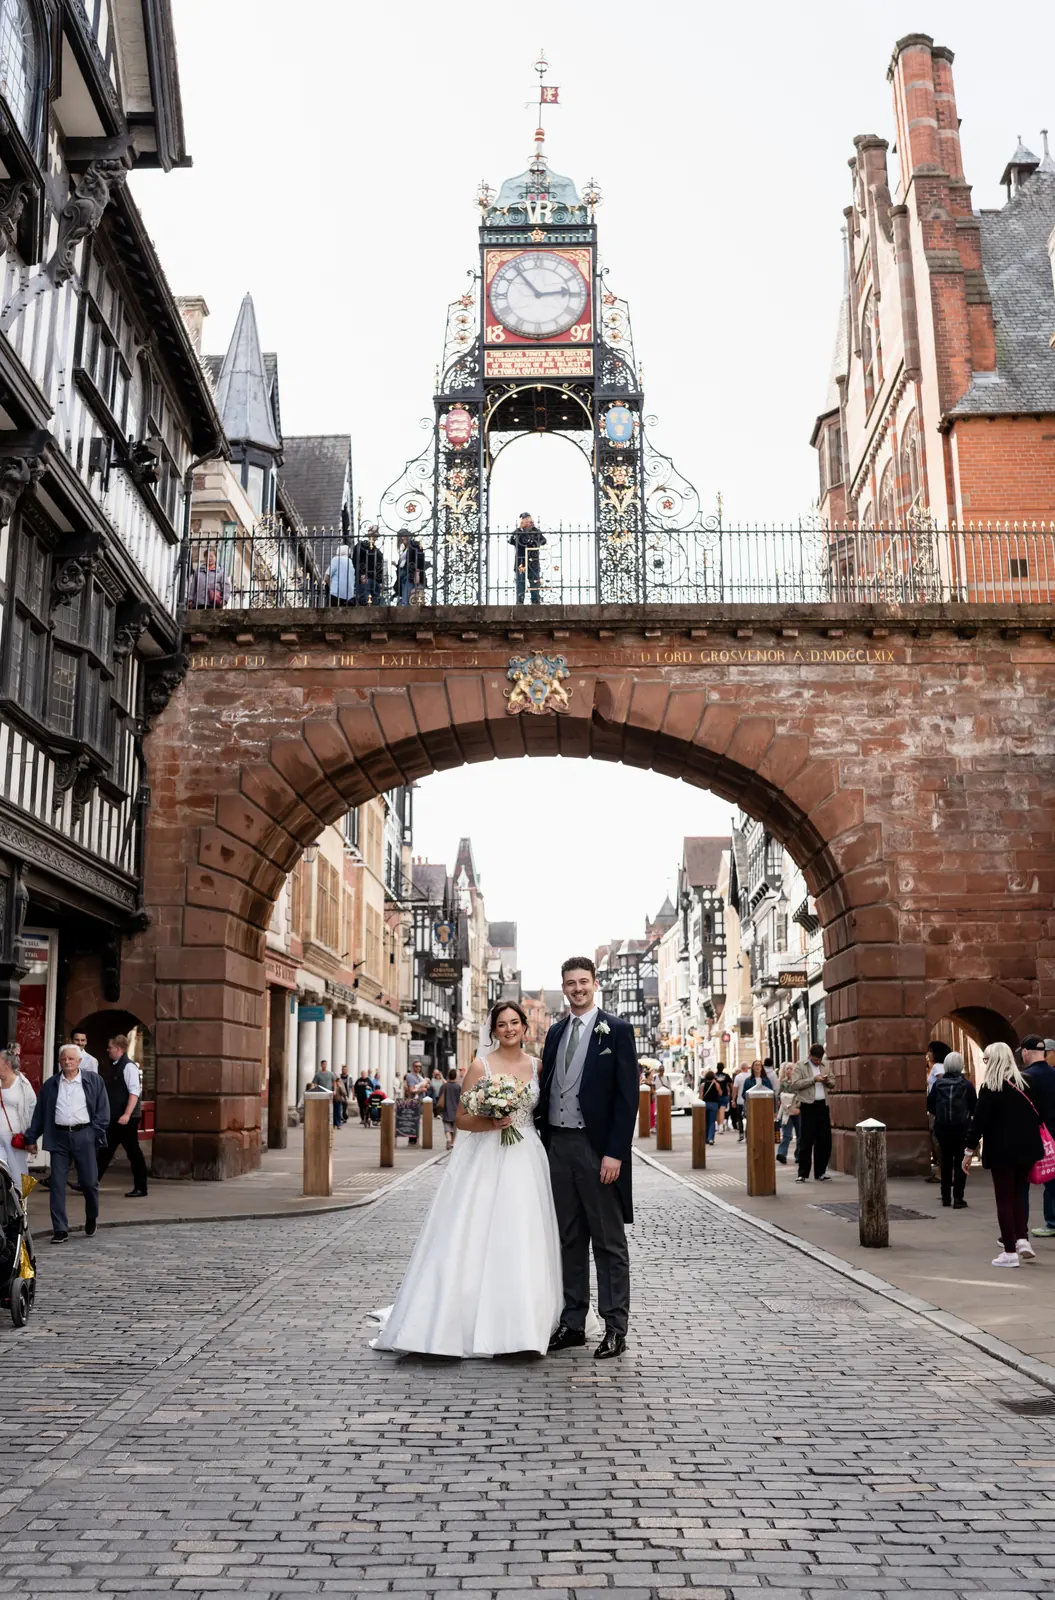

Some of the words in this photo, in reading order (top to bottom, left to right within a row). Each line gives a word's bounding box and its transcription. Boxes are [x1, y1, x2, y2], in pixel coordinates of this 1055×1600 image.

[524, 200, 553, 224] VR
[486, 325, 506, 342] 18
[570, 322, 591, 341] 97
[331, 655, 359, 666] THE
[656, 650, 692, 663] LORD
[700, 650, 786, 662] GROSVENOR
